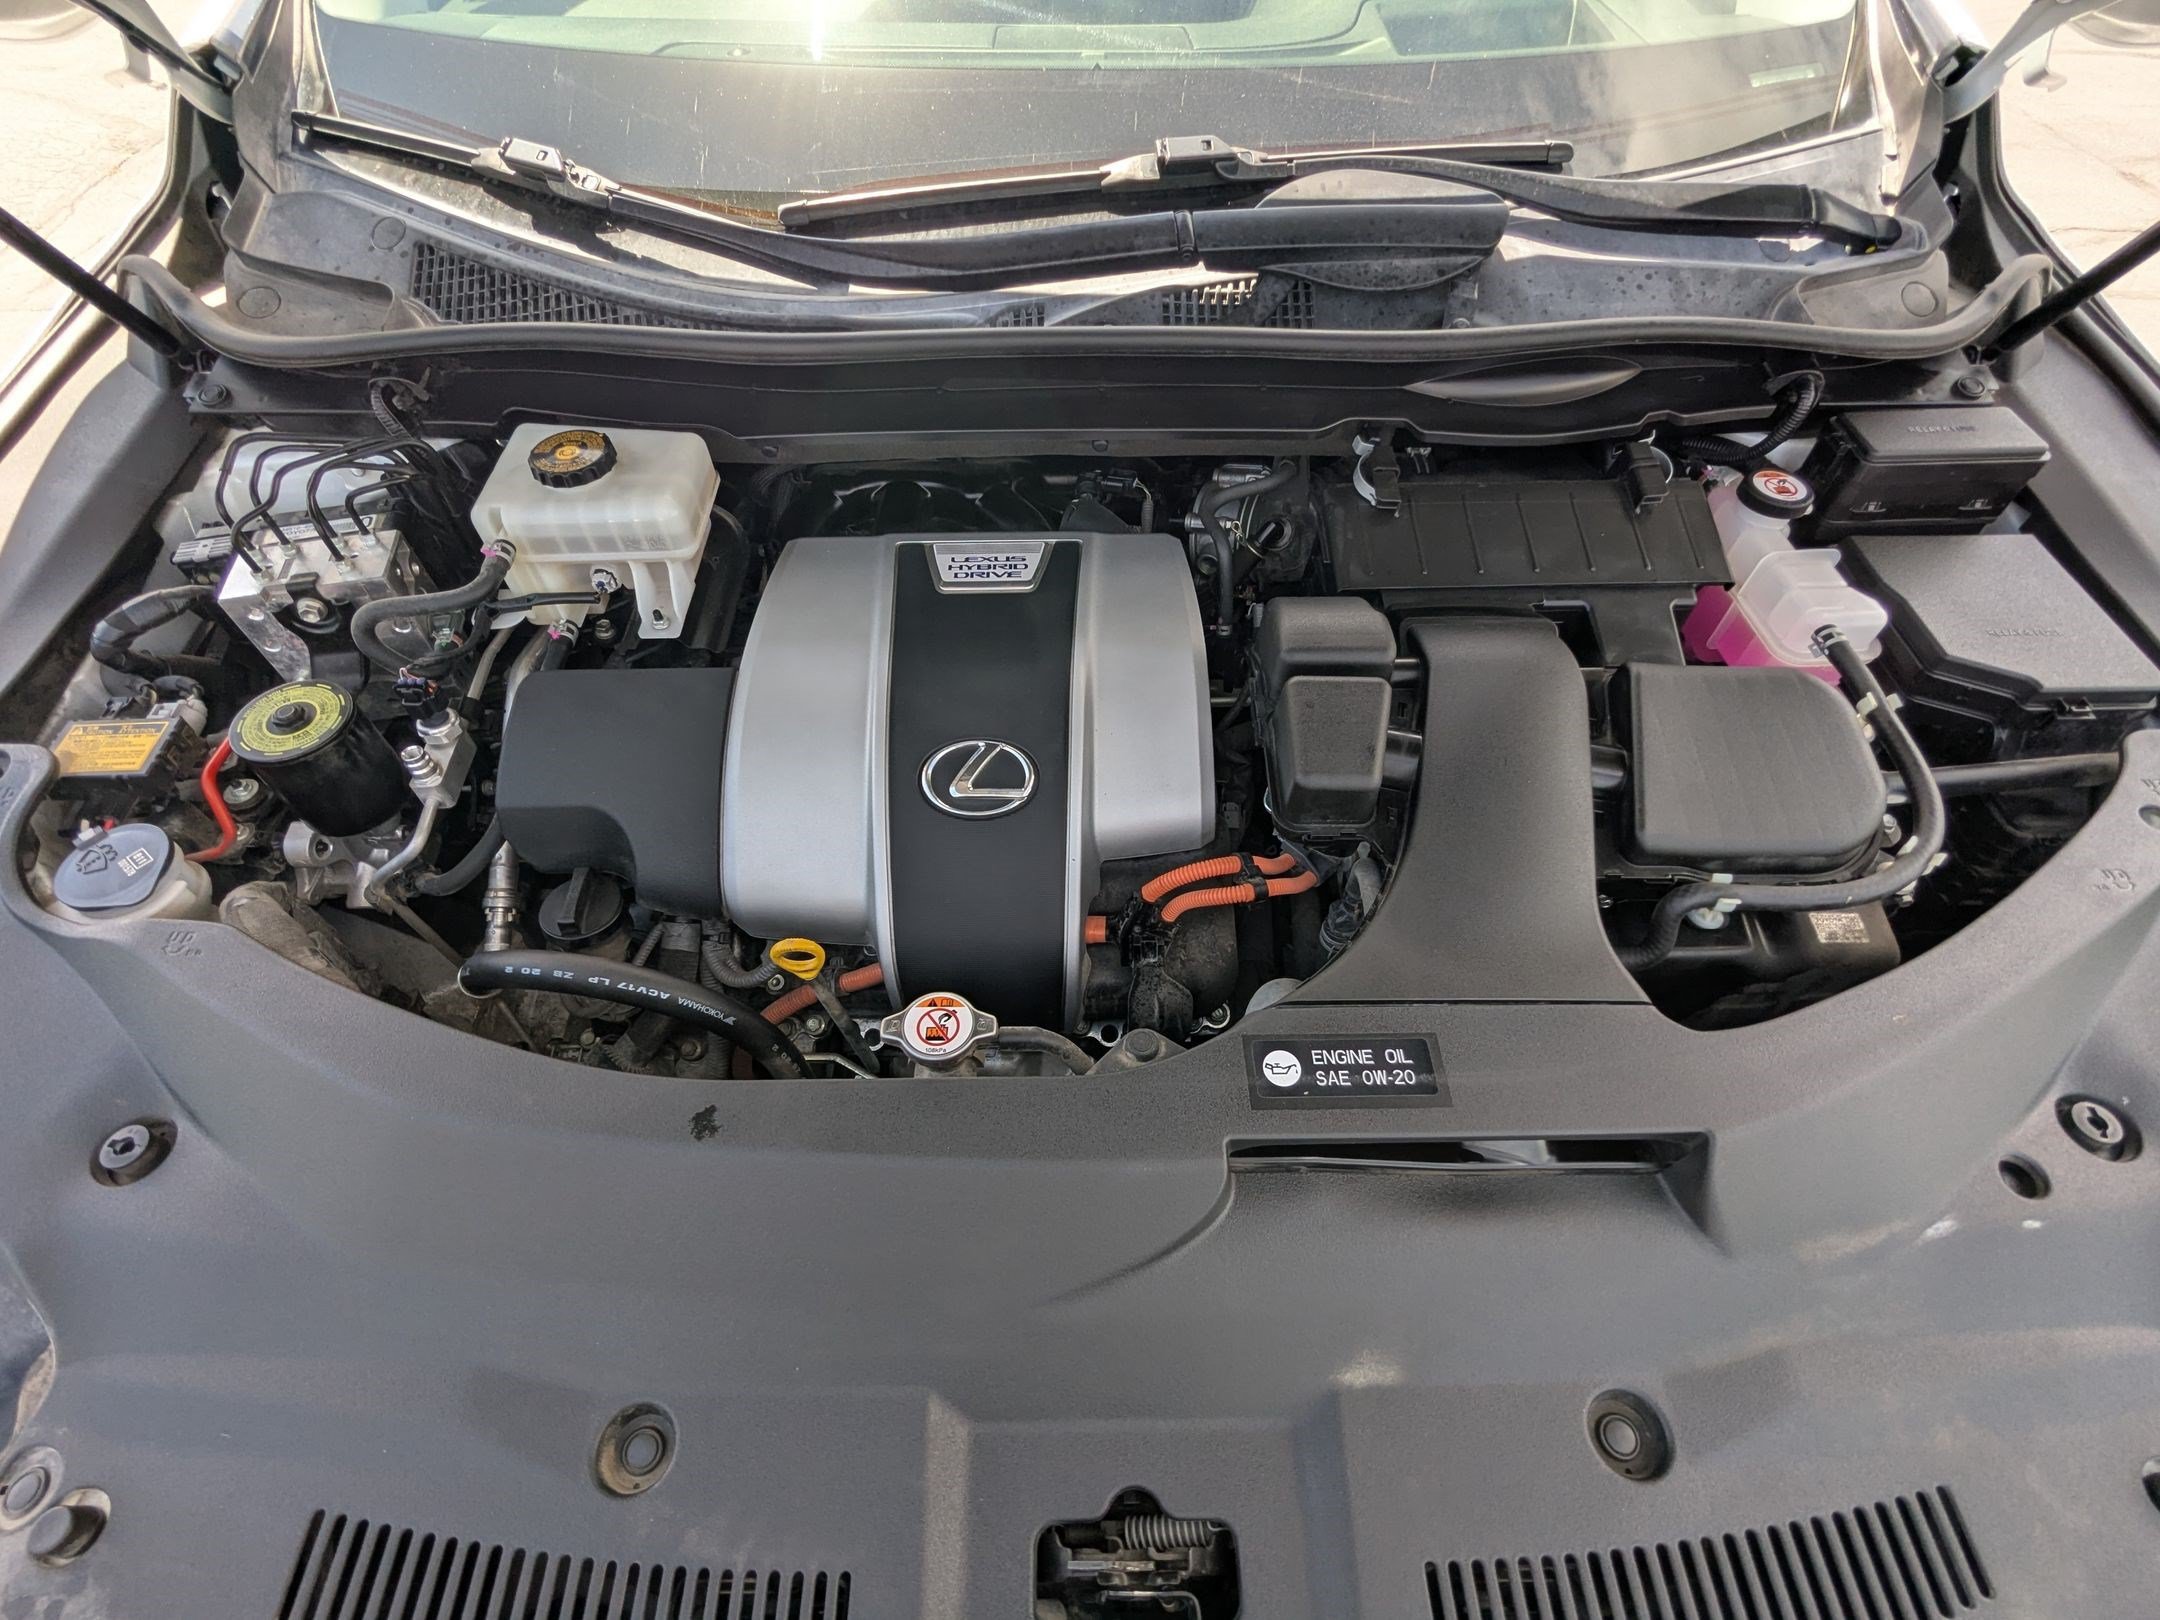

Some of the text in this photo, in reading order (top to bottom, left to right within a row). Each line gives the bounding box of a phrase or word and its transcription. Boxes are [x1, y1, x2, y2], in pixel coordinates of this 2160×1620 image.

[951, 555, 1027, 563] LEXUS
[948, 563, 1029, 571] HYBRID
[953, 571, 1022, 579] DRIVE
[588, 976, 610, 986] LP
[617, 982, 671, 1000] ACV17
[678, 996, 725, 1020] YOKOHAMA
[1311, 1048, 1414, 1065] ENGINE OIL
[1315, 1069, 1416, 1086] SAE 0W-20
